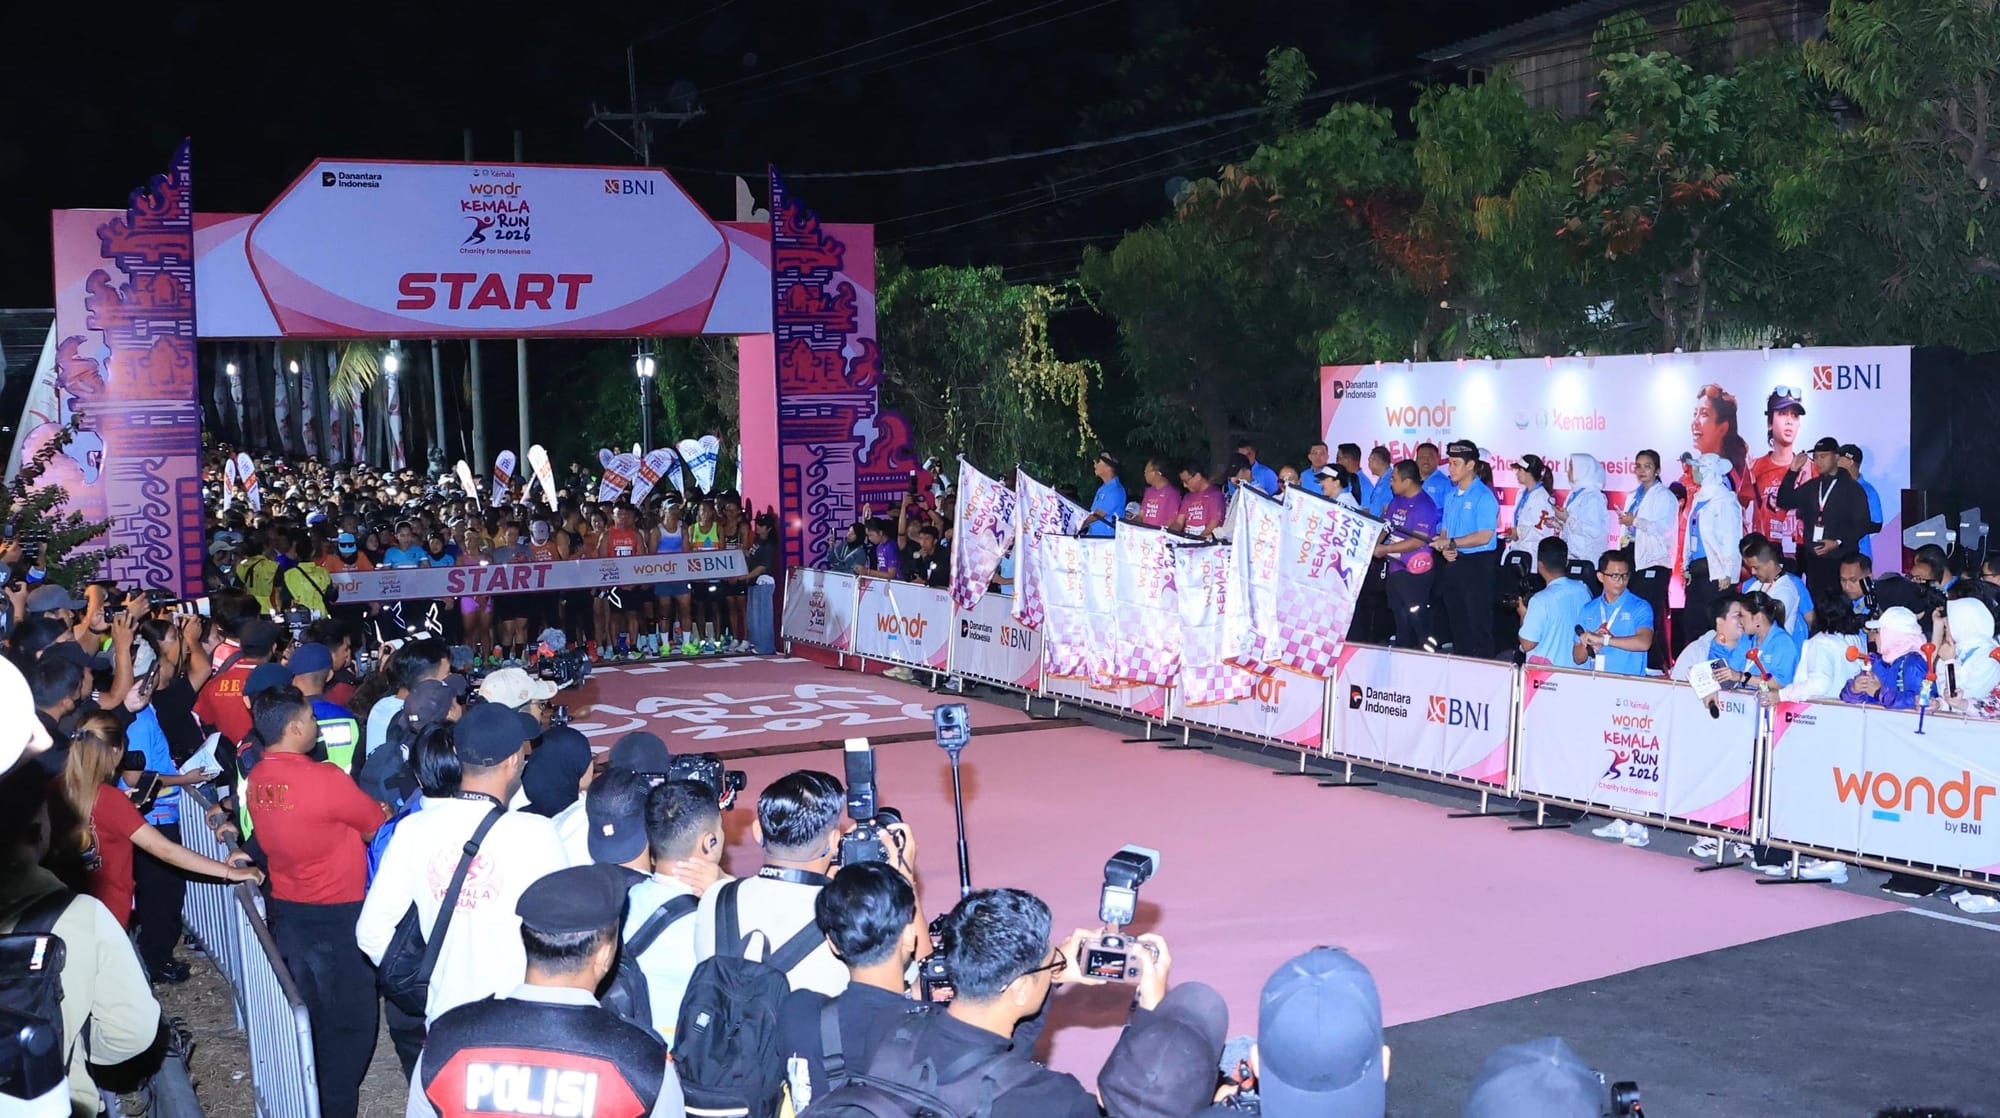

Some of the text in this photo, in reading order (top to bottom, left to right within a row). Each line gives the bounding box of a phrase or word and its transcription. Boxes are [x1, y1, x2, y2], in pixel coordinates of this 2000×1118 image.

[339, 172, 382, 180] Danantara
[491, 169, 515, 178] Kemala
[339, 180, 380, 188] Indonesia
[470, 182, 522, 195] wondr
[623, 179, 654, 195] BNI
[461, 199, 530, 214] KEMALA
[497, 213, 529, 228] RUN
[495, 227, 531, 241] 2026
[459, 248, 485, 256] Charity
[397, 272, 593, 310] START
[1345, 380, 1378, 390] Danantara
[1837, 364, 1881, 390] BNI
[1345, 390, 1377, 399] Indonesia
[1386, 400, 1457, 427] wondr
[1553, 408, 1606, 430] Kemala
[963, 483, 985, 521] wondr
[969, 484, 1000, 535] KEMALA
[992, 489, 1010, 515] RUN
[1029, 494, 1057, 549] KEMALA
[1333, 514, 1352, 548] RUN
[1297, 512, 1320, 564] wondr
[1308, 508, 1341, 579] KEMALA
[1346, 517, 1365, 557] 2026
[633, 560, 678, 575] wondr
[704, 555, 735, 571] BNI
[446, 564, 553, 594] START
[1213, 548, 1228, 615] KEMALA
[877, 613, 928, 639] wondr
[969, 620, 993, 634] Danantara
[969, 630, 991, 643] Indonesia
[1011, 628, 1032, 652] BNI
[219, 679, 241, 692] BE
[1366, 686, 1411, 704] Danantara
[653, 698, 904, 724] RUN
[1365, 701, 1408, 718] Indonesia
[1448, 698, 1489, 731] BNI
[1726, 702, 1745, 714] BNI
[1612, 714, 1654, 729] wondr
[1604, 730, 1660, 751] KEMALA
[1631, 749, 1659, 766] RUN
[1628, 766, 1659, 782] 2026
[1598, 782, 1659, 797] Charity for Indonesia
[1833, 766, 1996, 821] wondr
[1945, 820, 1982, 836] by BNI
[466, 1063, 599, 1118] POLISI
